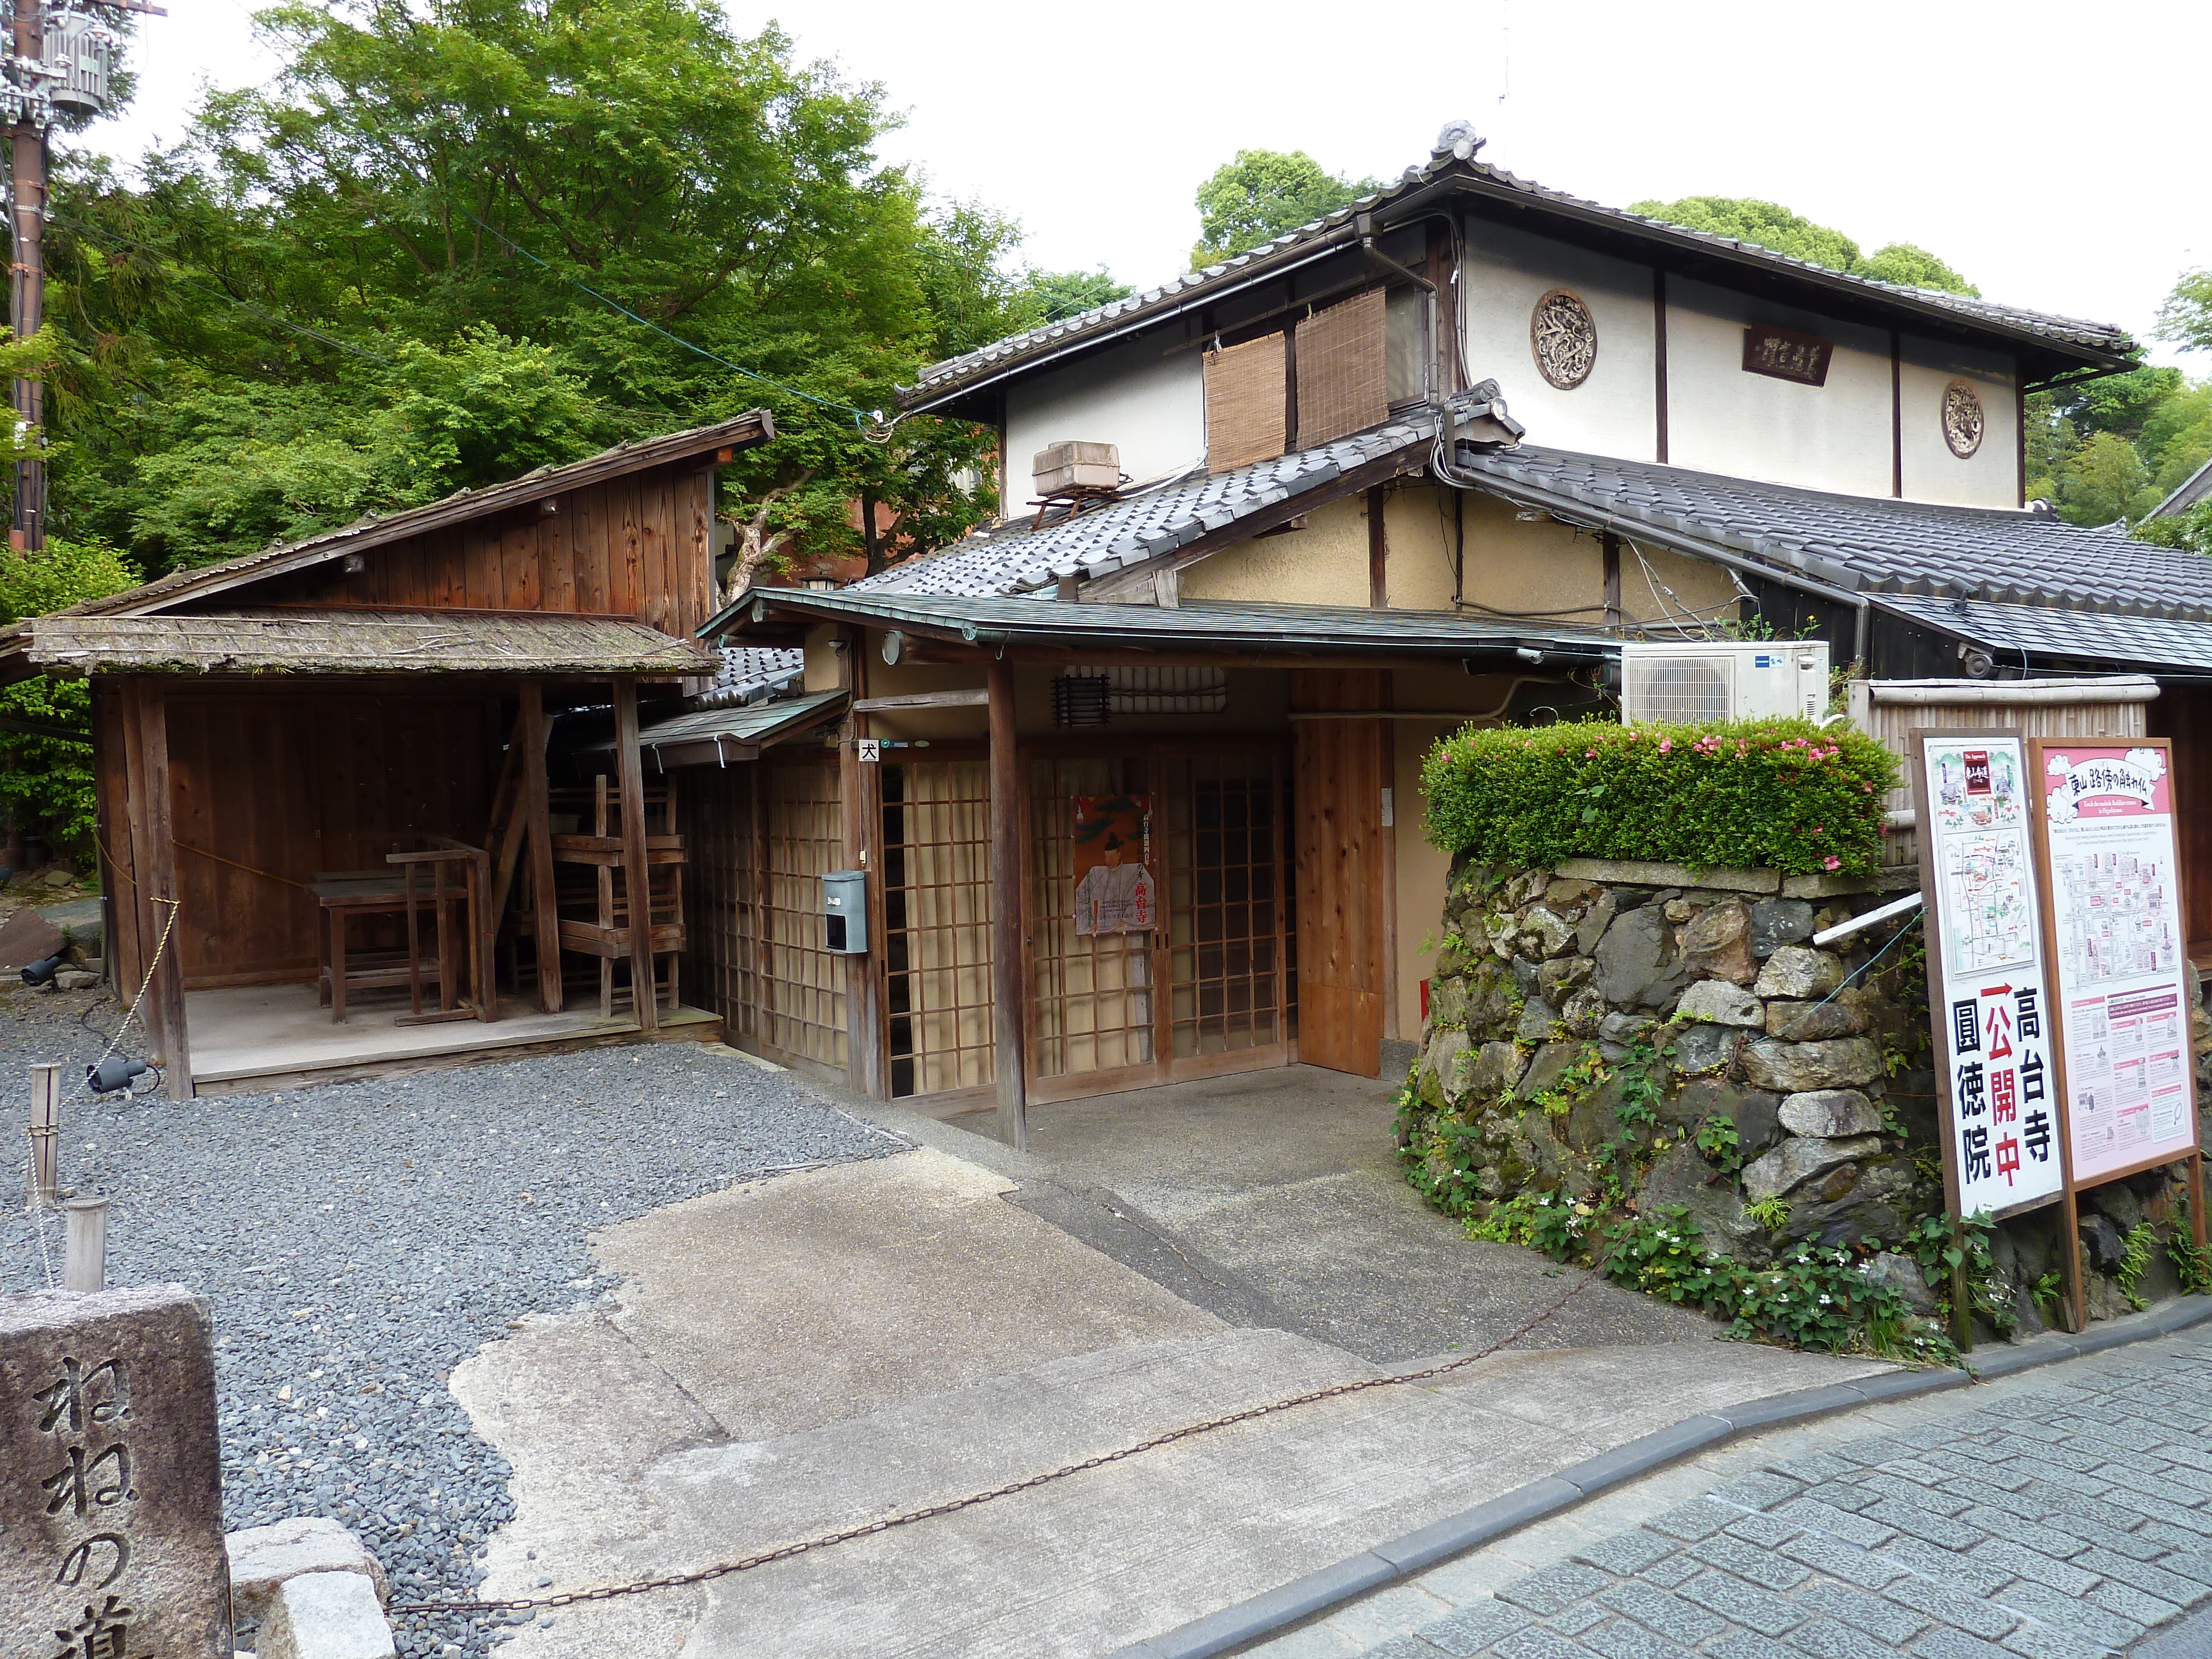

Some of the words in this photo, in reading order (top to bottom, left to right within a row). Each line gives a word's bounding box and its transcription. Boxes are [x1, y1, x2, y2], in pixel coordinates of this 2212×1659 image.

[862, 743, 877, 759] 犬
[1135, 881, 1147, 923] 高台寺
[1952, 998, 1991, 1184] 圓徳院
[1985, 1005, 2020, 1187] 公開中
[2013, 987, 2051, 1162] 高台寺
[33, 1355, 154, 1659] ねねの道
